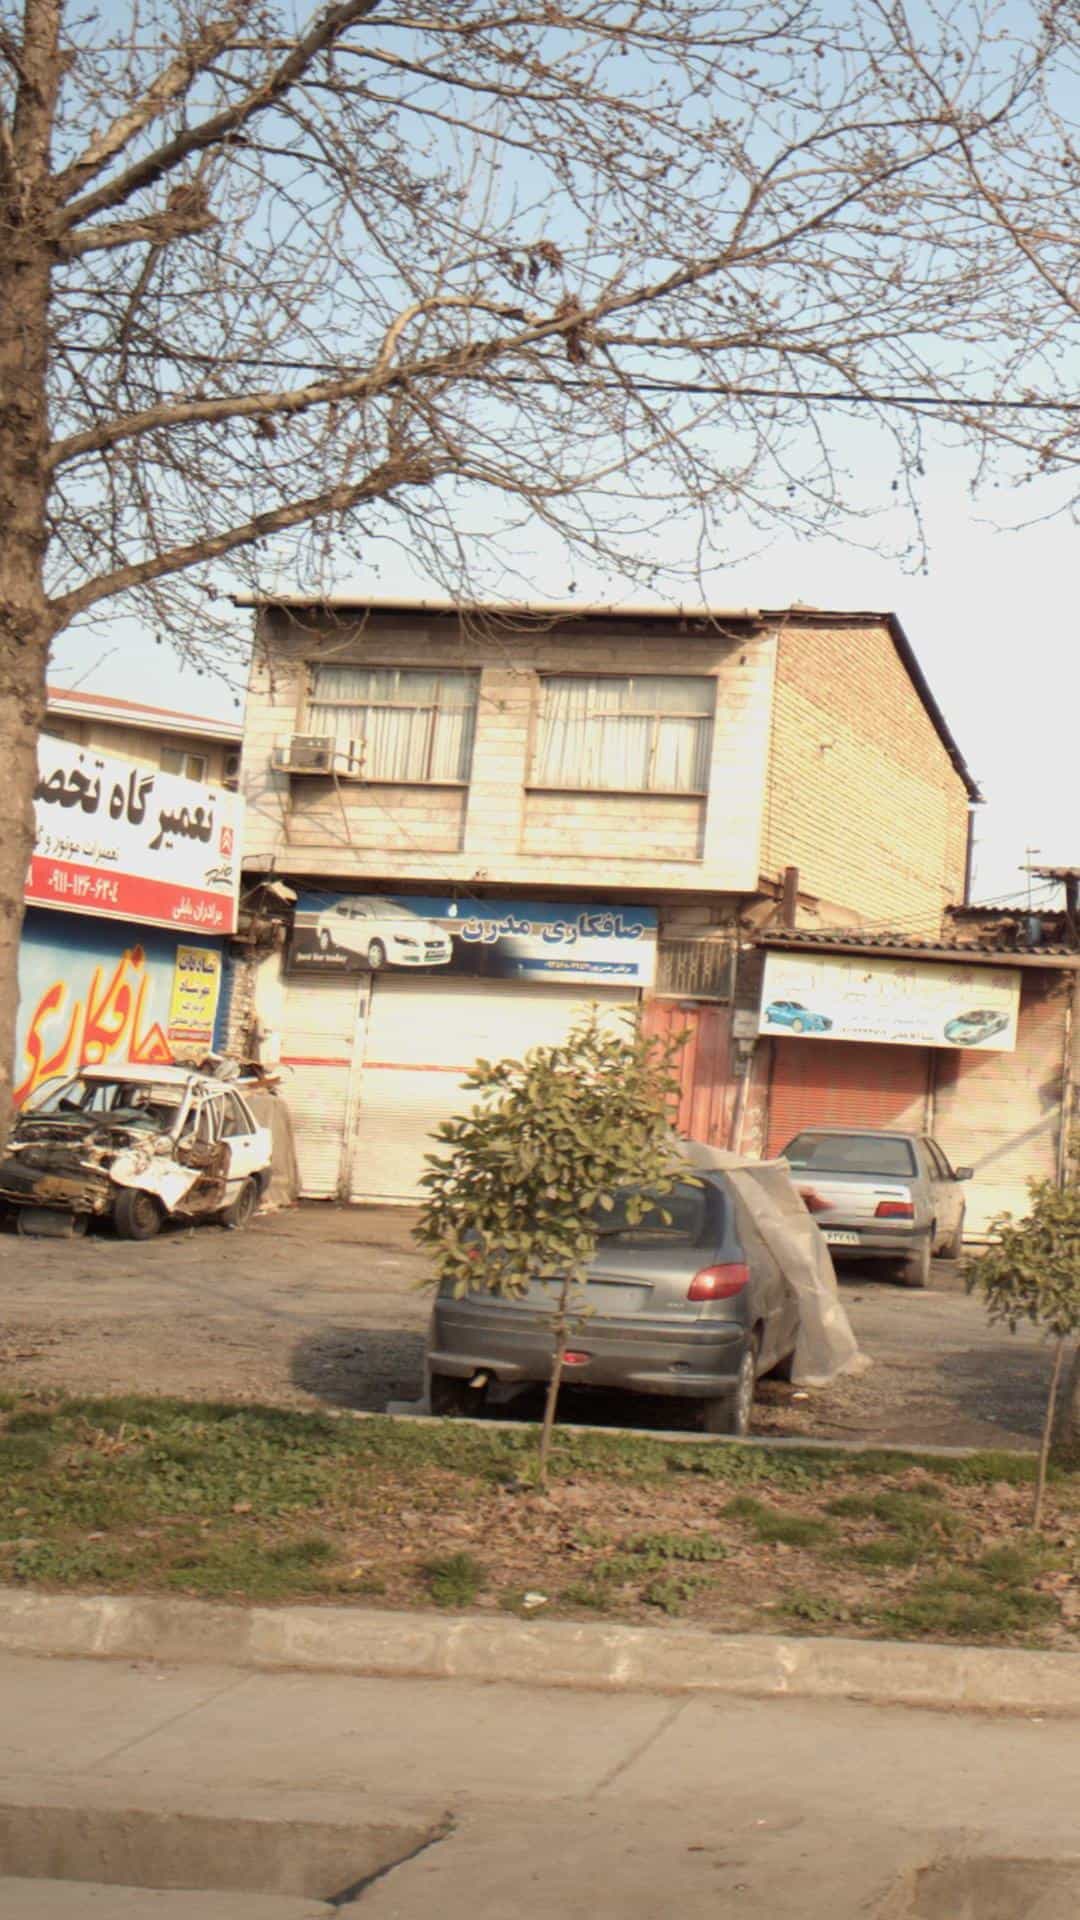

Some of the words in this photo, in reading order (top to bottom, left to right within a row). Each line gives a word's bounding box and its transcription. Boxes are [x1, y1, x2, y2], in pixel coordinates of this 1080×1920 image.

[32, 754, 104, 814] تخص
[109, 768, 154, 825] گاه
[149, 794, 216, 850] تعمیر
[461, 914, 530, 944] مدرن
[541, 912, 644, 944] صافکاری
